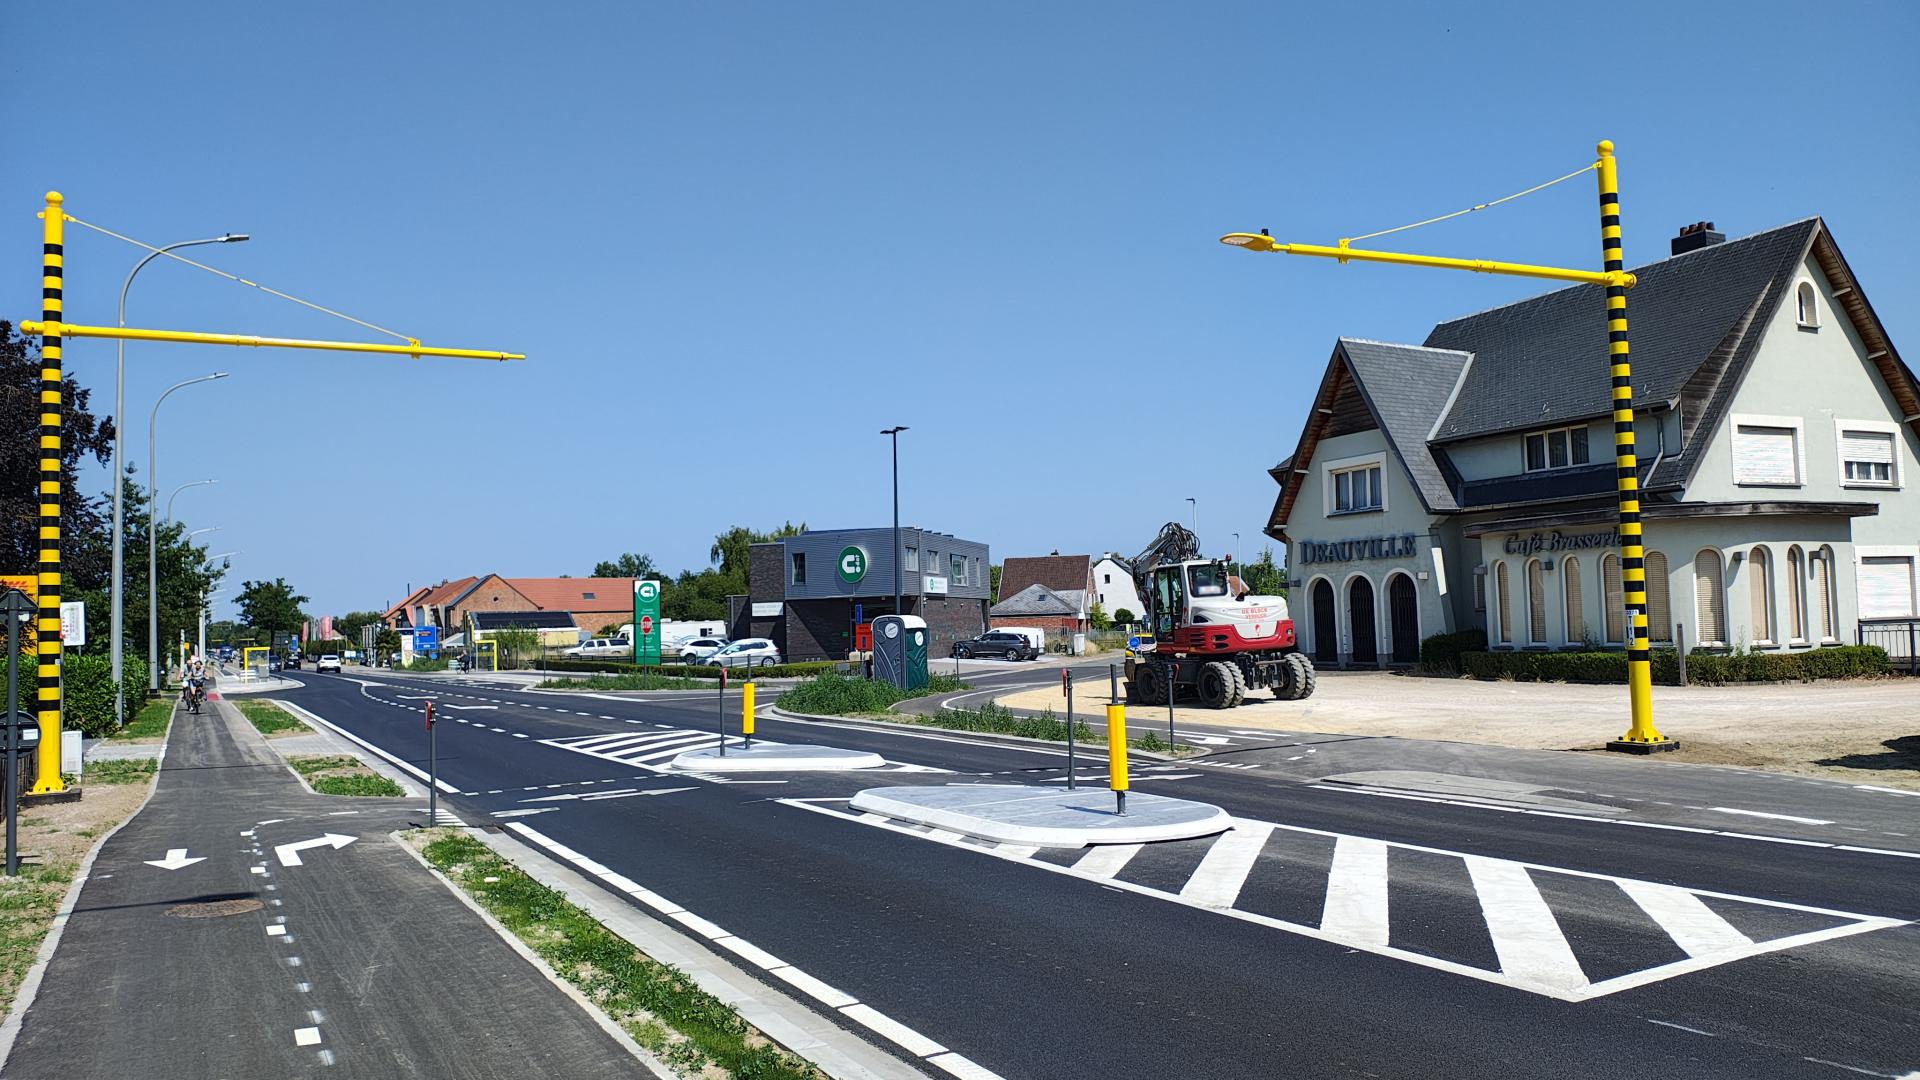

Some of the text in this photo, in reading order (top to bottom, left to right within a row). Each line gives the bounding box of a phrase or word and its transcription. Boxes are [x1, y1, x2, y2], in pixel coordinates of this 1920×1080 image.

[1299, 534, 1416, 565] DEAUVILLE
[1503, 527, 1622, 556] Café Brasserie
